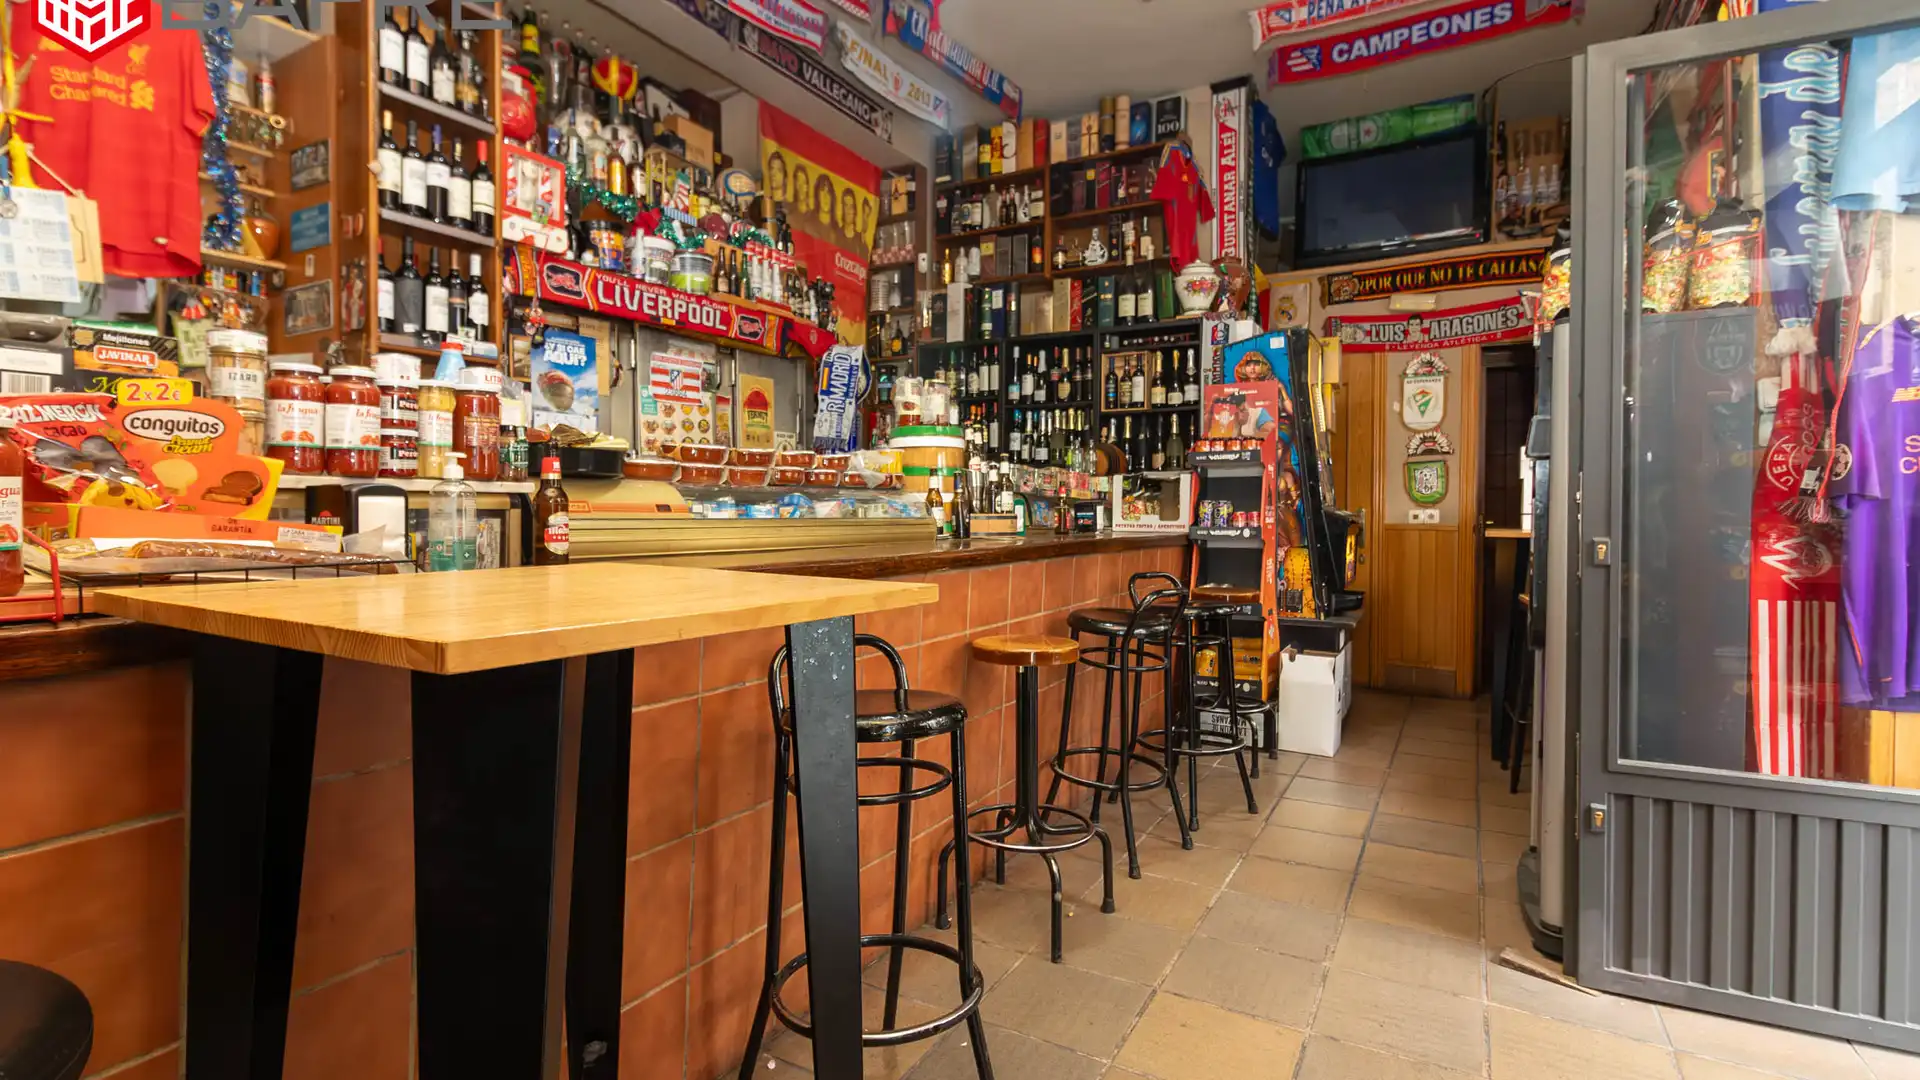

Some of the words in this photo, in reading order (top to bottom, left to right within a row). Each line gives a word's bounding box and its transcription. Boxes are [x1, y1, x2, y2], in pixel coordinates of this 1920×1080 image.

[1331, 2, 1513, 64] CAMPEONES
[848, 40, 888, 81] FINAL
[802, 61, 871, 122] VALLECANO
[1157, 120, 1179, 135] 100
[1396, 271, 1425, 288] QUE
[1429, 267, 1452, 283] NO
[1457, 264, 1474, 280] TE
[595, 272, 630, 288] YOU'LL
[635, 282, 667, 295] NEVER
[671, 291, 696, 303] WALK
[701, 298, 729, 313] ALONE
[597, 280, 728, 331] LIVERPOOL
[1369, 322, 1406, 342] LUIS
[1429, 304, 1520, 339] ARAGONÉS
[102, 332, 151, 347] Mejillones
[1397, 341, 1439, 351] LEYENDA
[129, 415, 220, 437] conguitos
[311, 516, 341, 525] MARTINI
